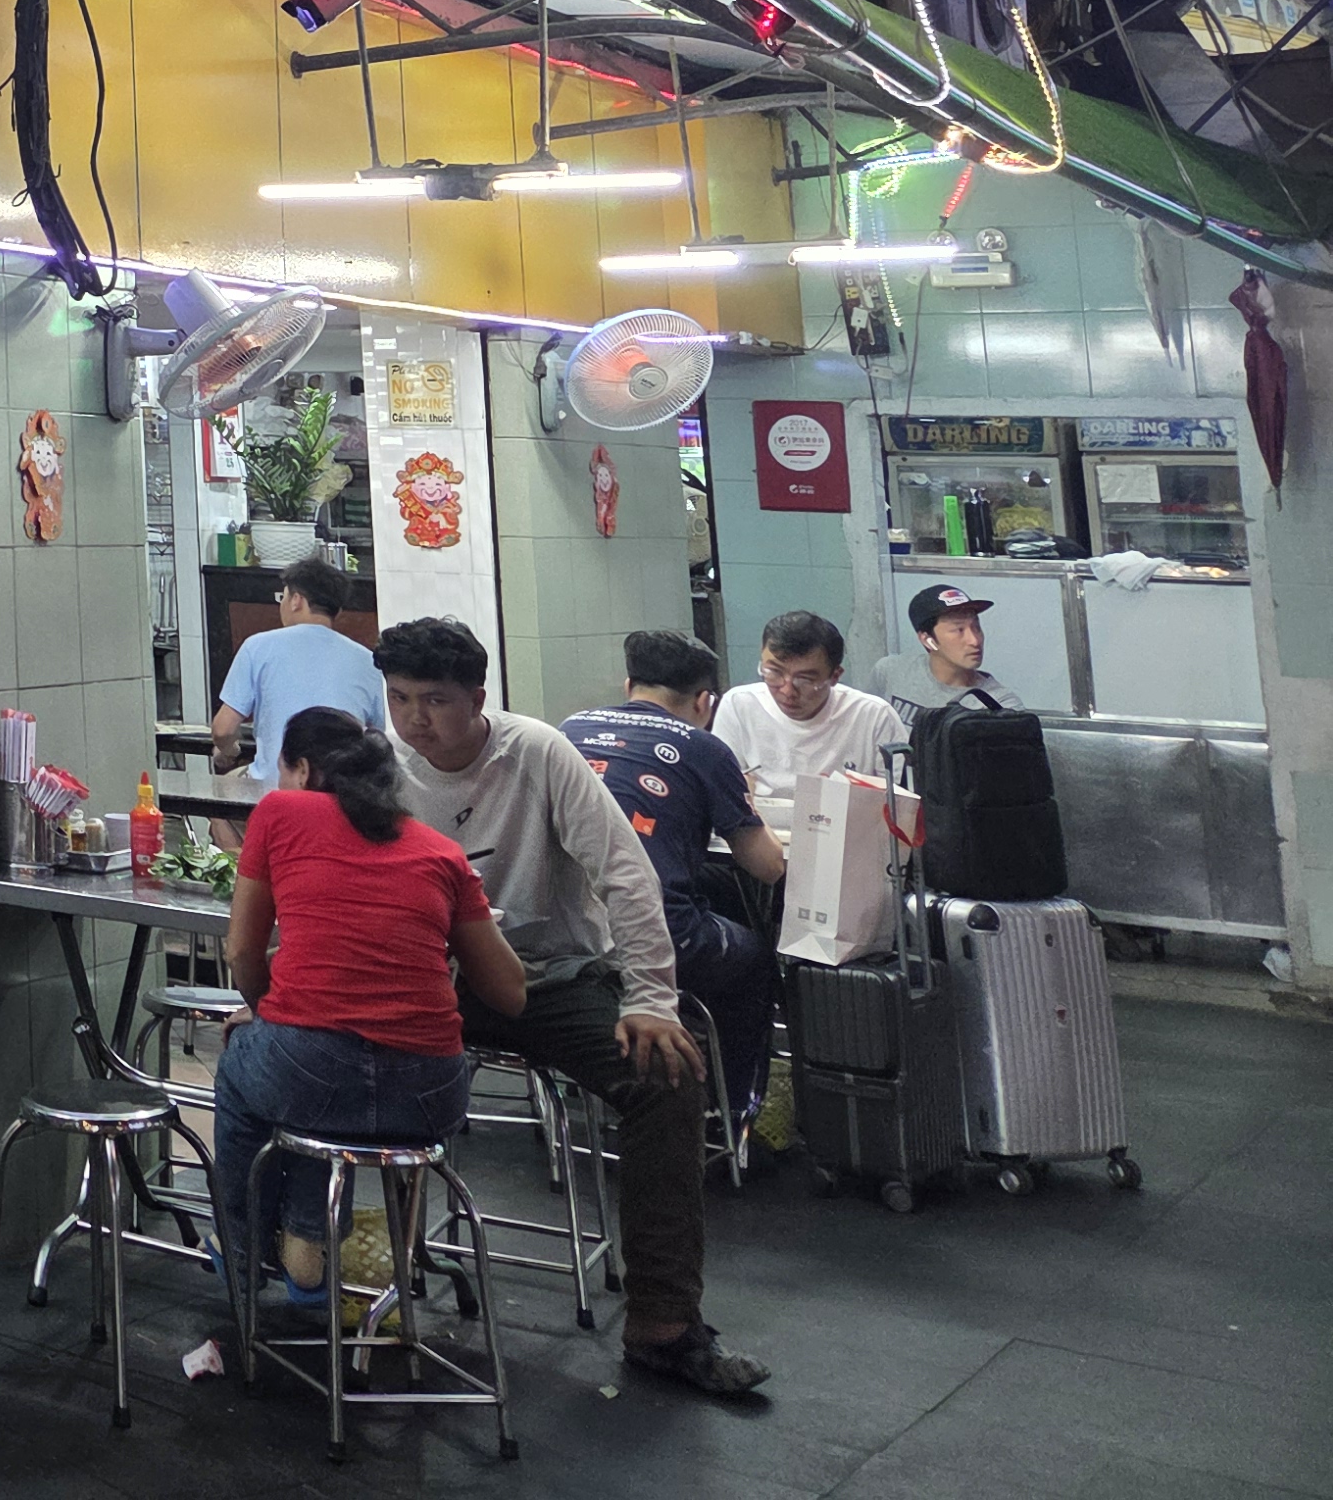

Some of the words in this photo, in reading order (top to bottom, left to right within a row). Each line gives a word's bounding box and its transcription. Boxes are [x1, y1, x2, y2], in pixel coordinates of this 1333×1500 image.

[391, 379, 414, 395] NO
[393, 397, 451, 409] SMOKING
[906, 423, 1030, 445] DARLING
[1089, 421, 1171, 434] DARLING
